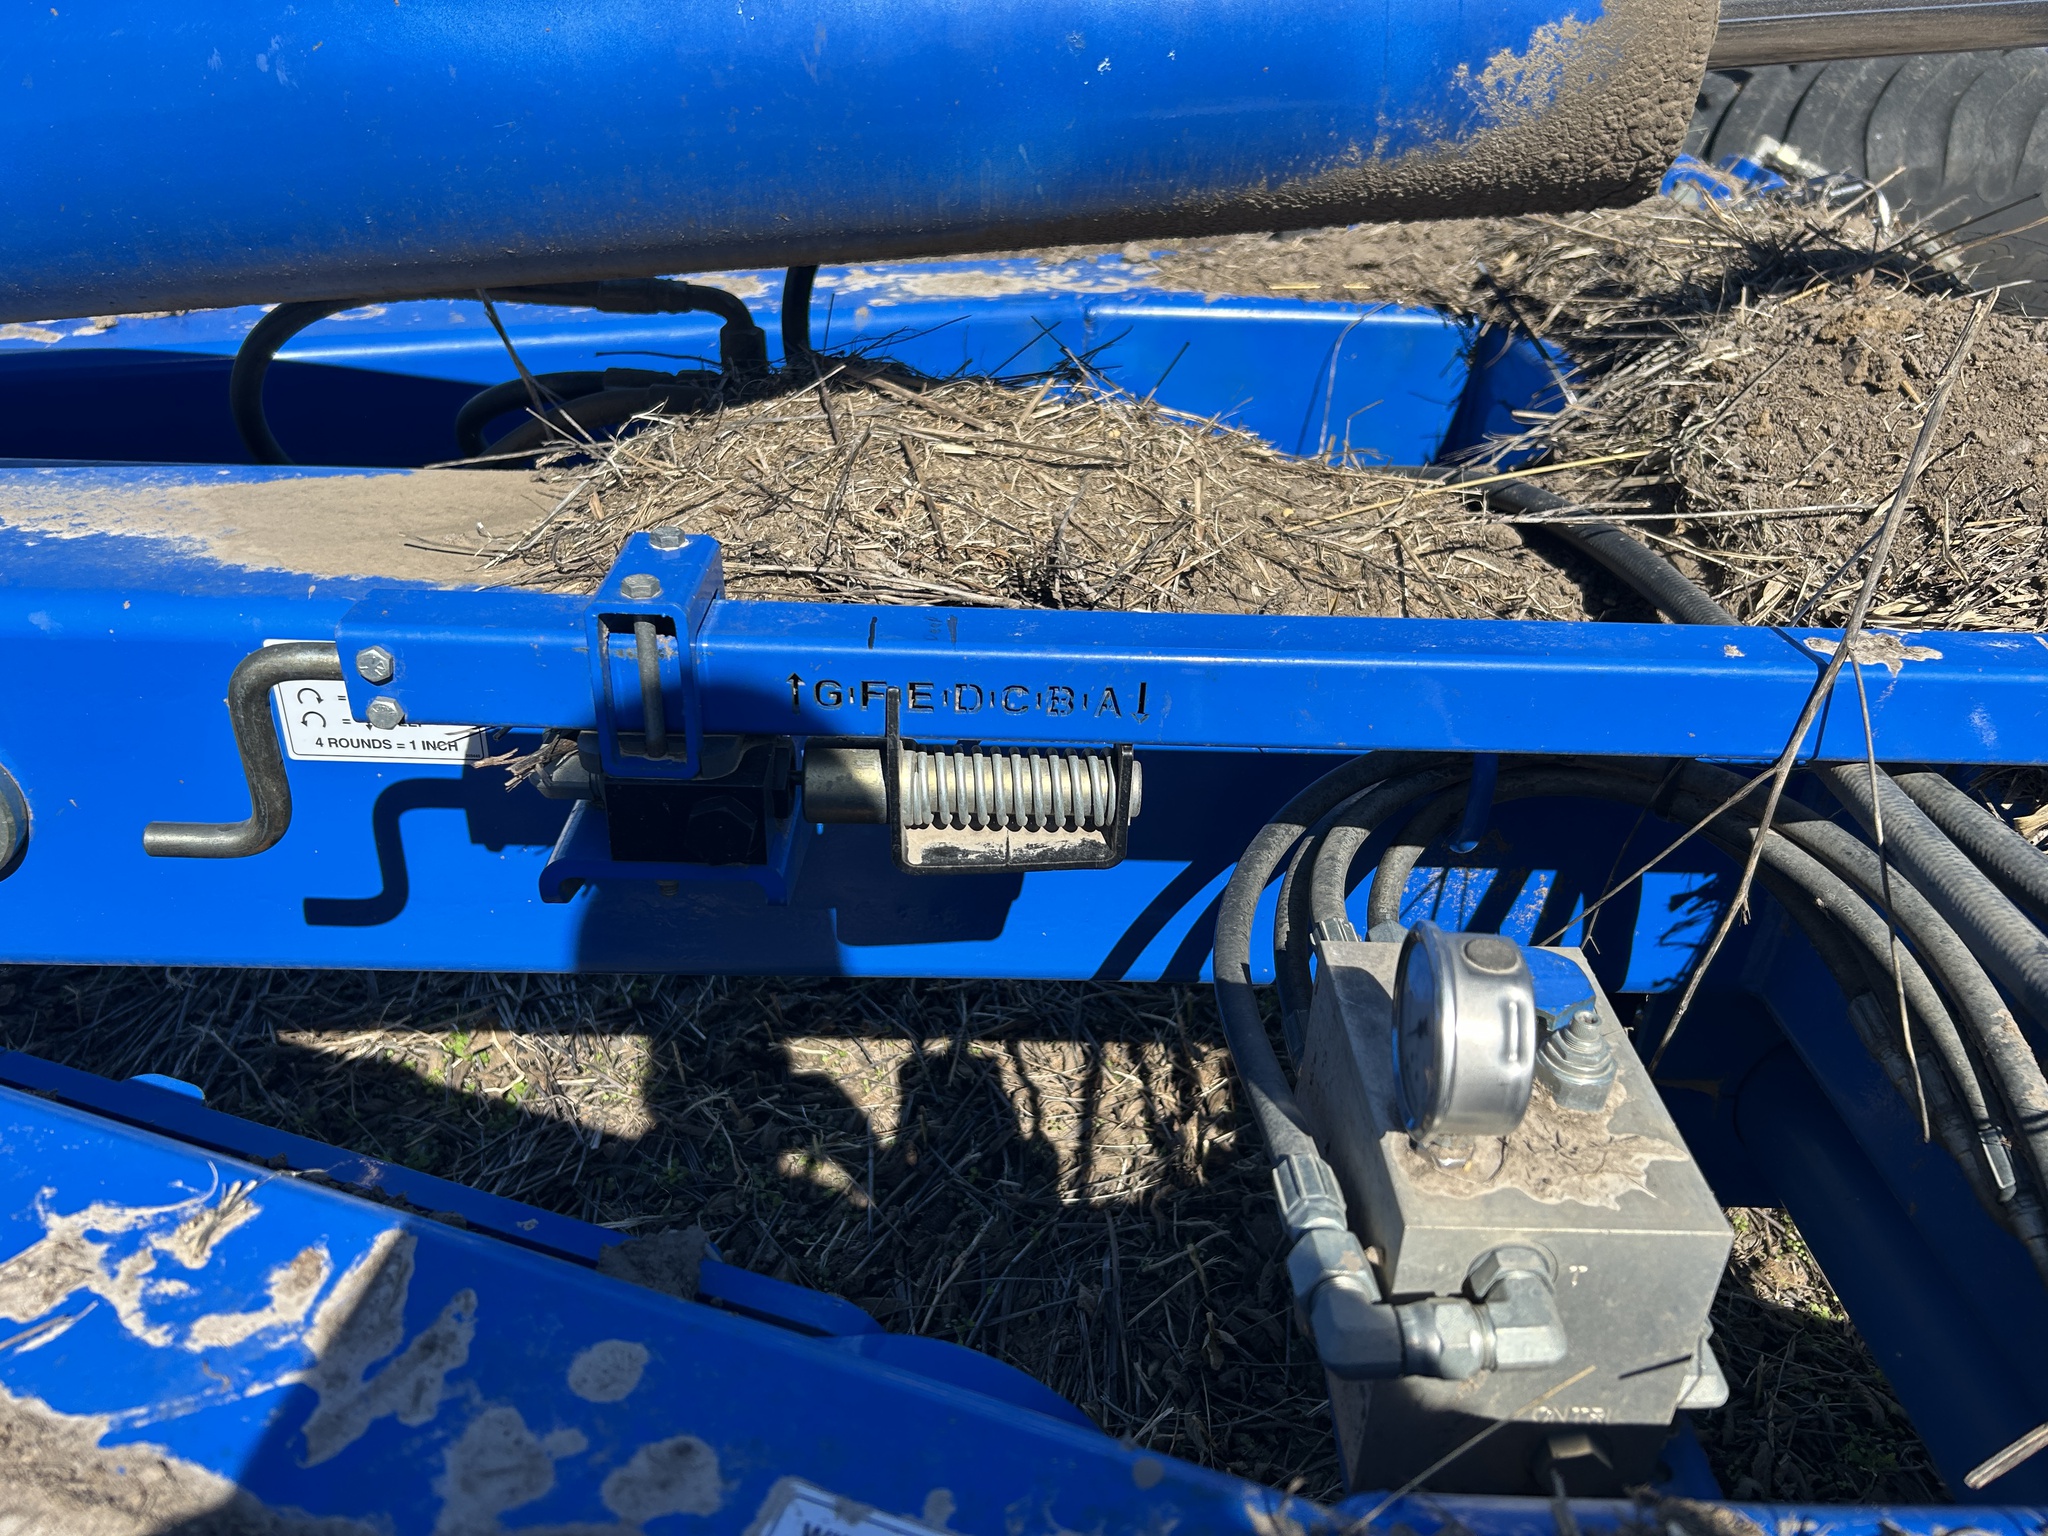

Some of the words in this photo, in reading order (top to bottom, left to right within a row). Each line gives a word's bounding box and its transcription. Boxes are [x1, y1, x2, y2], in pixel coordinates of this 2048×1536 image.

[315, 738, 324, 748] 4
[328, 737, 393, 750] ROUNDS
[409, 740, 417, 751] 1
[421, 740, 459, 752] INCH
